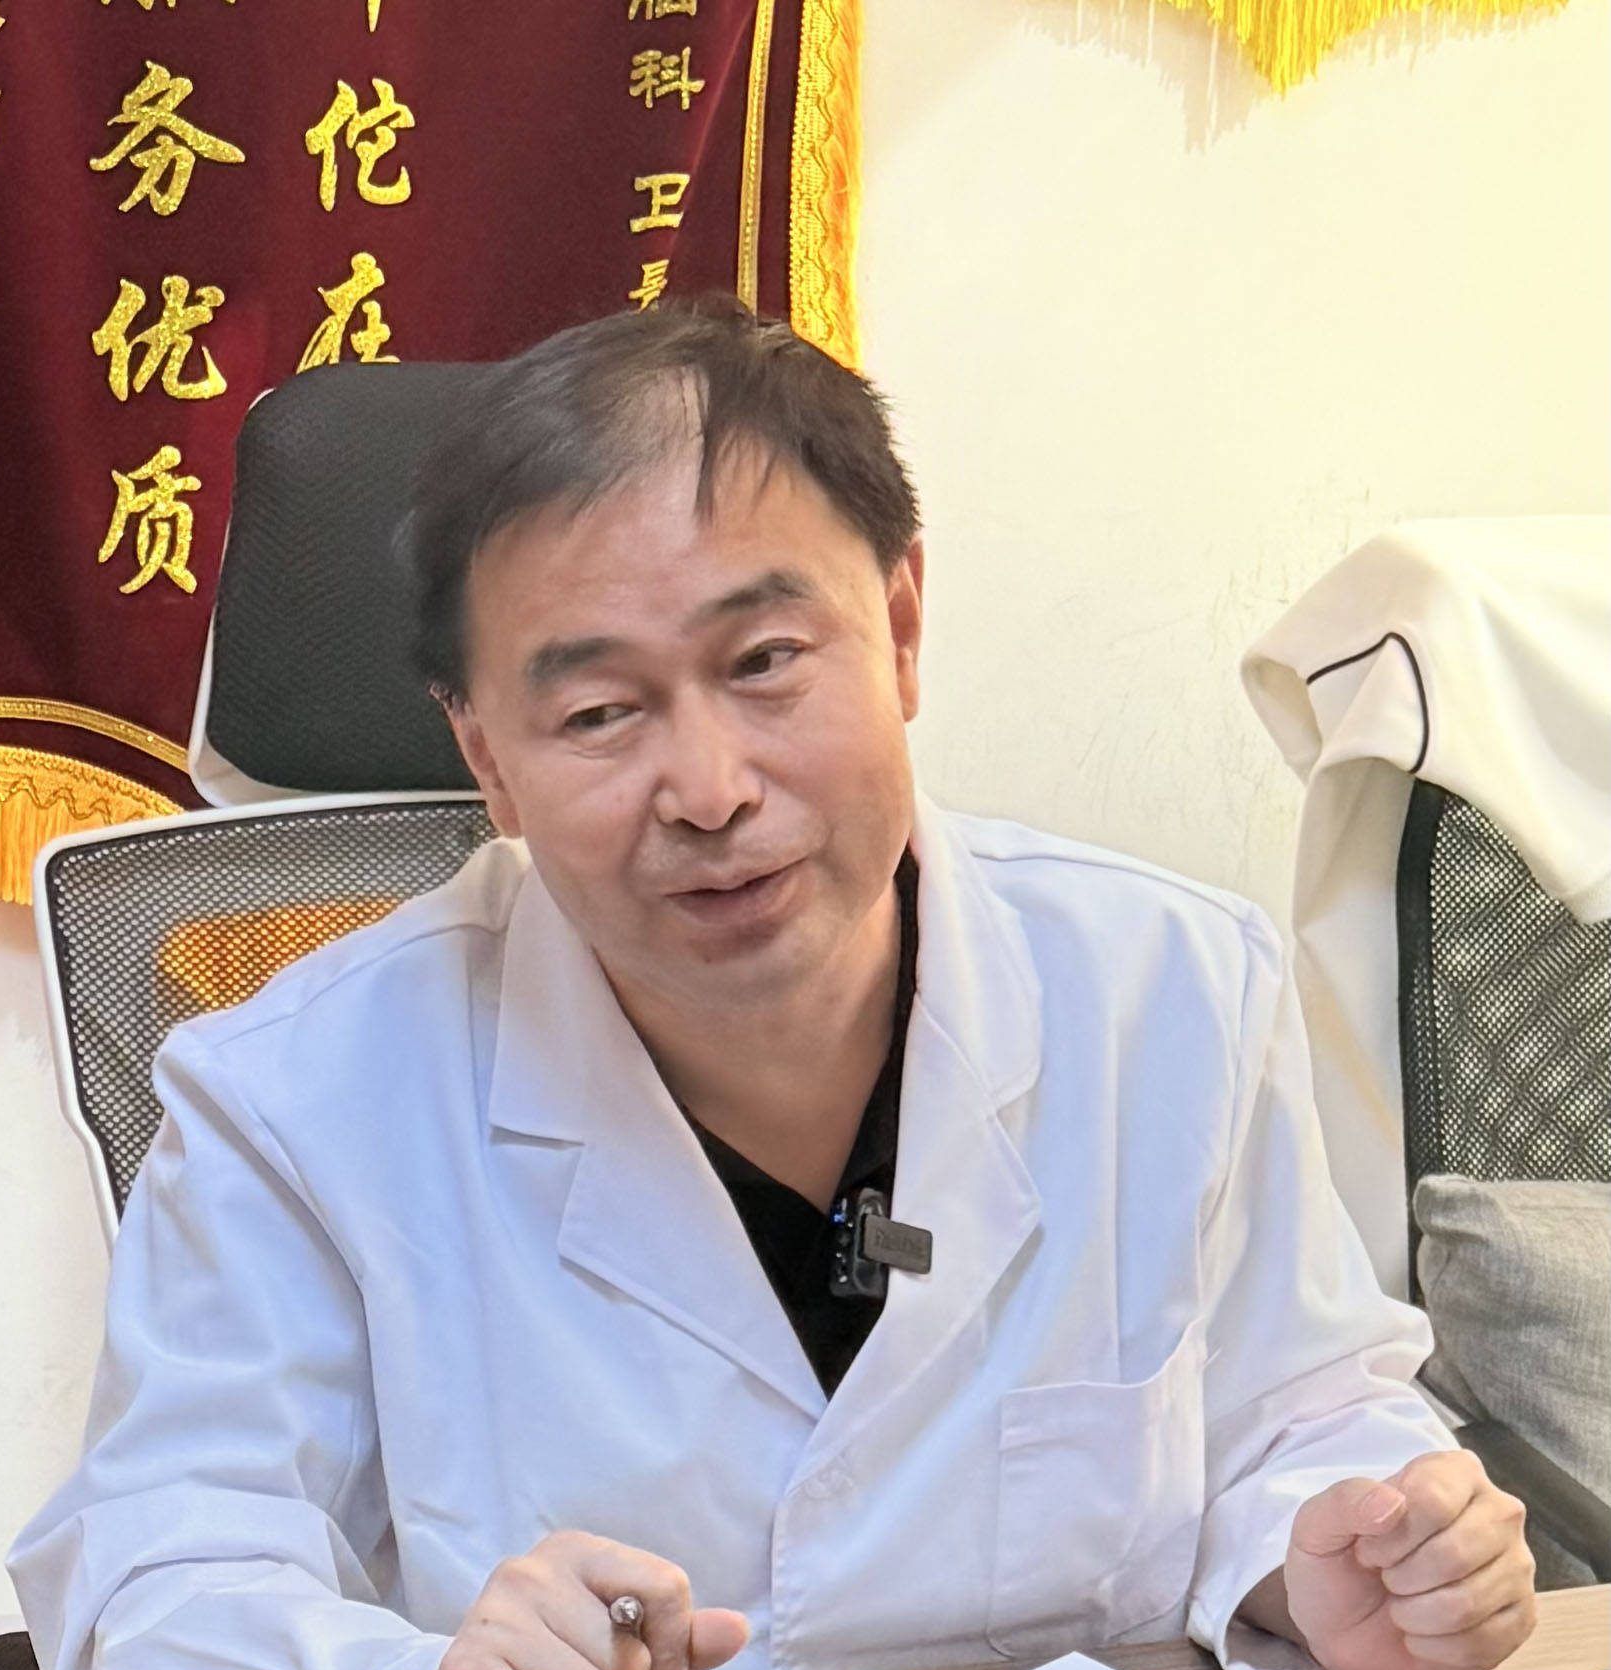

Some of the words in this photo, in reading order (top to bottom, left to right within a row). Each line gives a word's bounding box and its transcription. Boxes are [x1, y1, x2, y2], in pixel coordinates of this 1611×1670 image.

[90, 0, 246, 595] 务优质
[296, 0, 416, 374] 佗在
